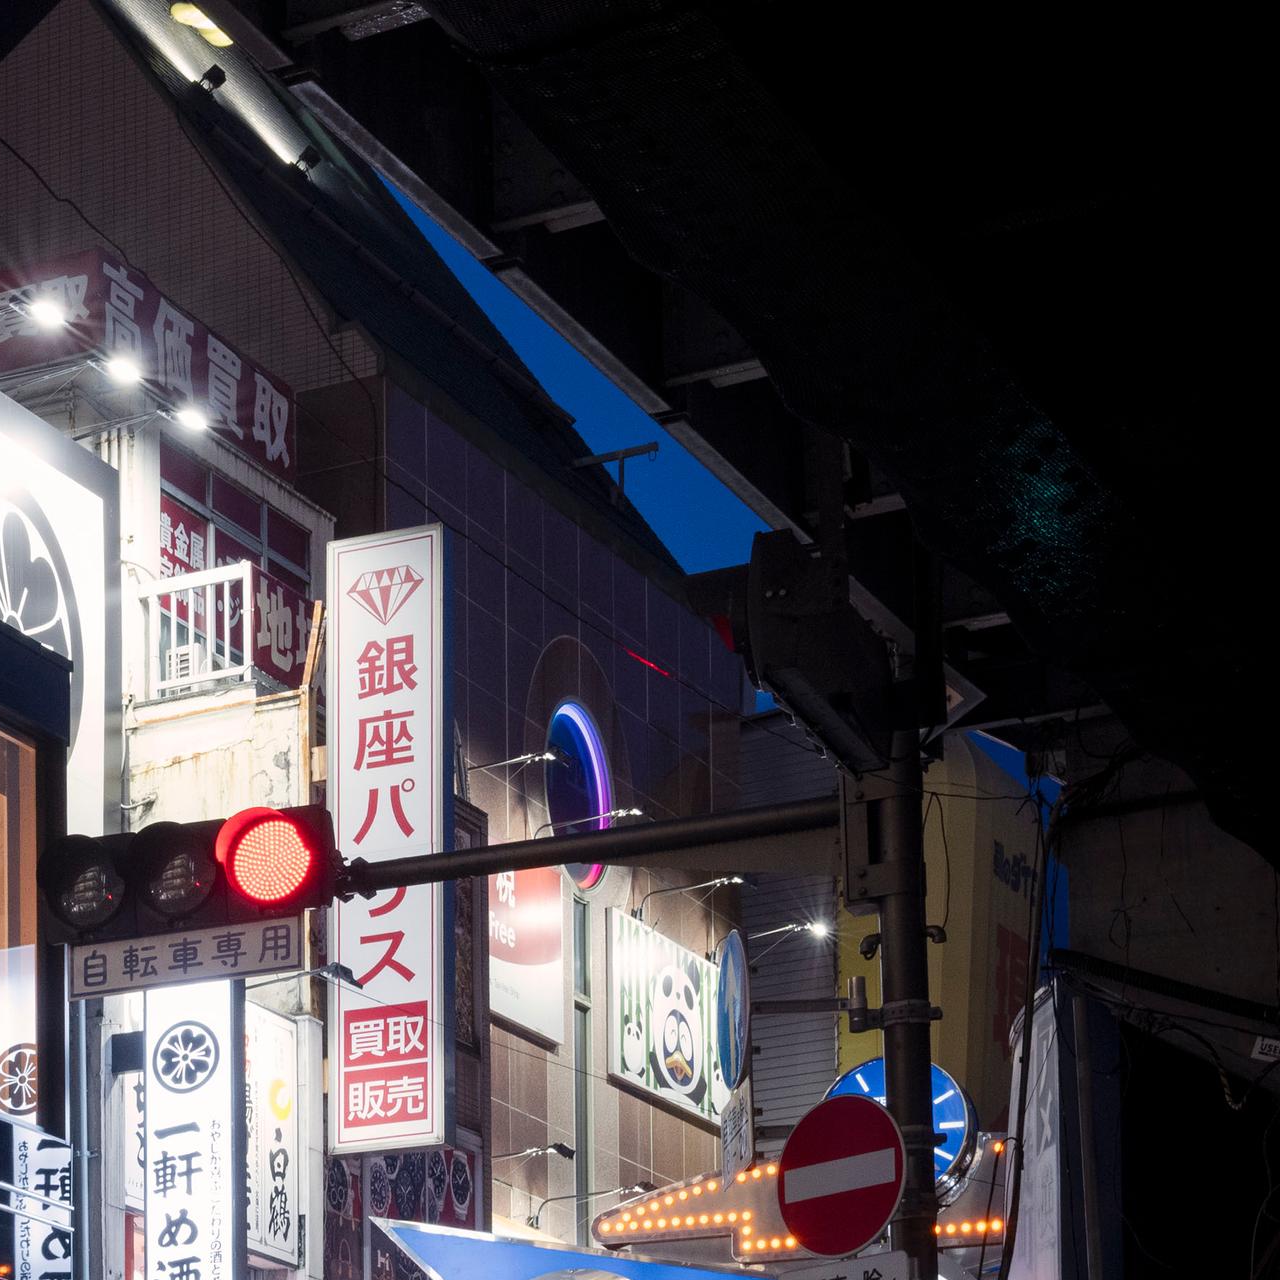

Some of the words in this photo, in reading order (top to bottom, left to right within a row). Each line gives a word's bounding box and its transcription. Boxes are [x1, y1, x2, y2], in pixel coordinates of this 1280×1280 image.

[82, 924, 294, 988] 自転車専用
[347, 1015, 426, 1060] 買取
[347, 1075, 426, 1121] 販売
